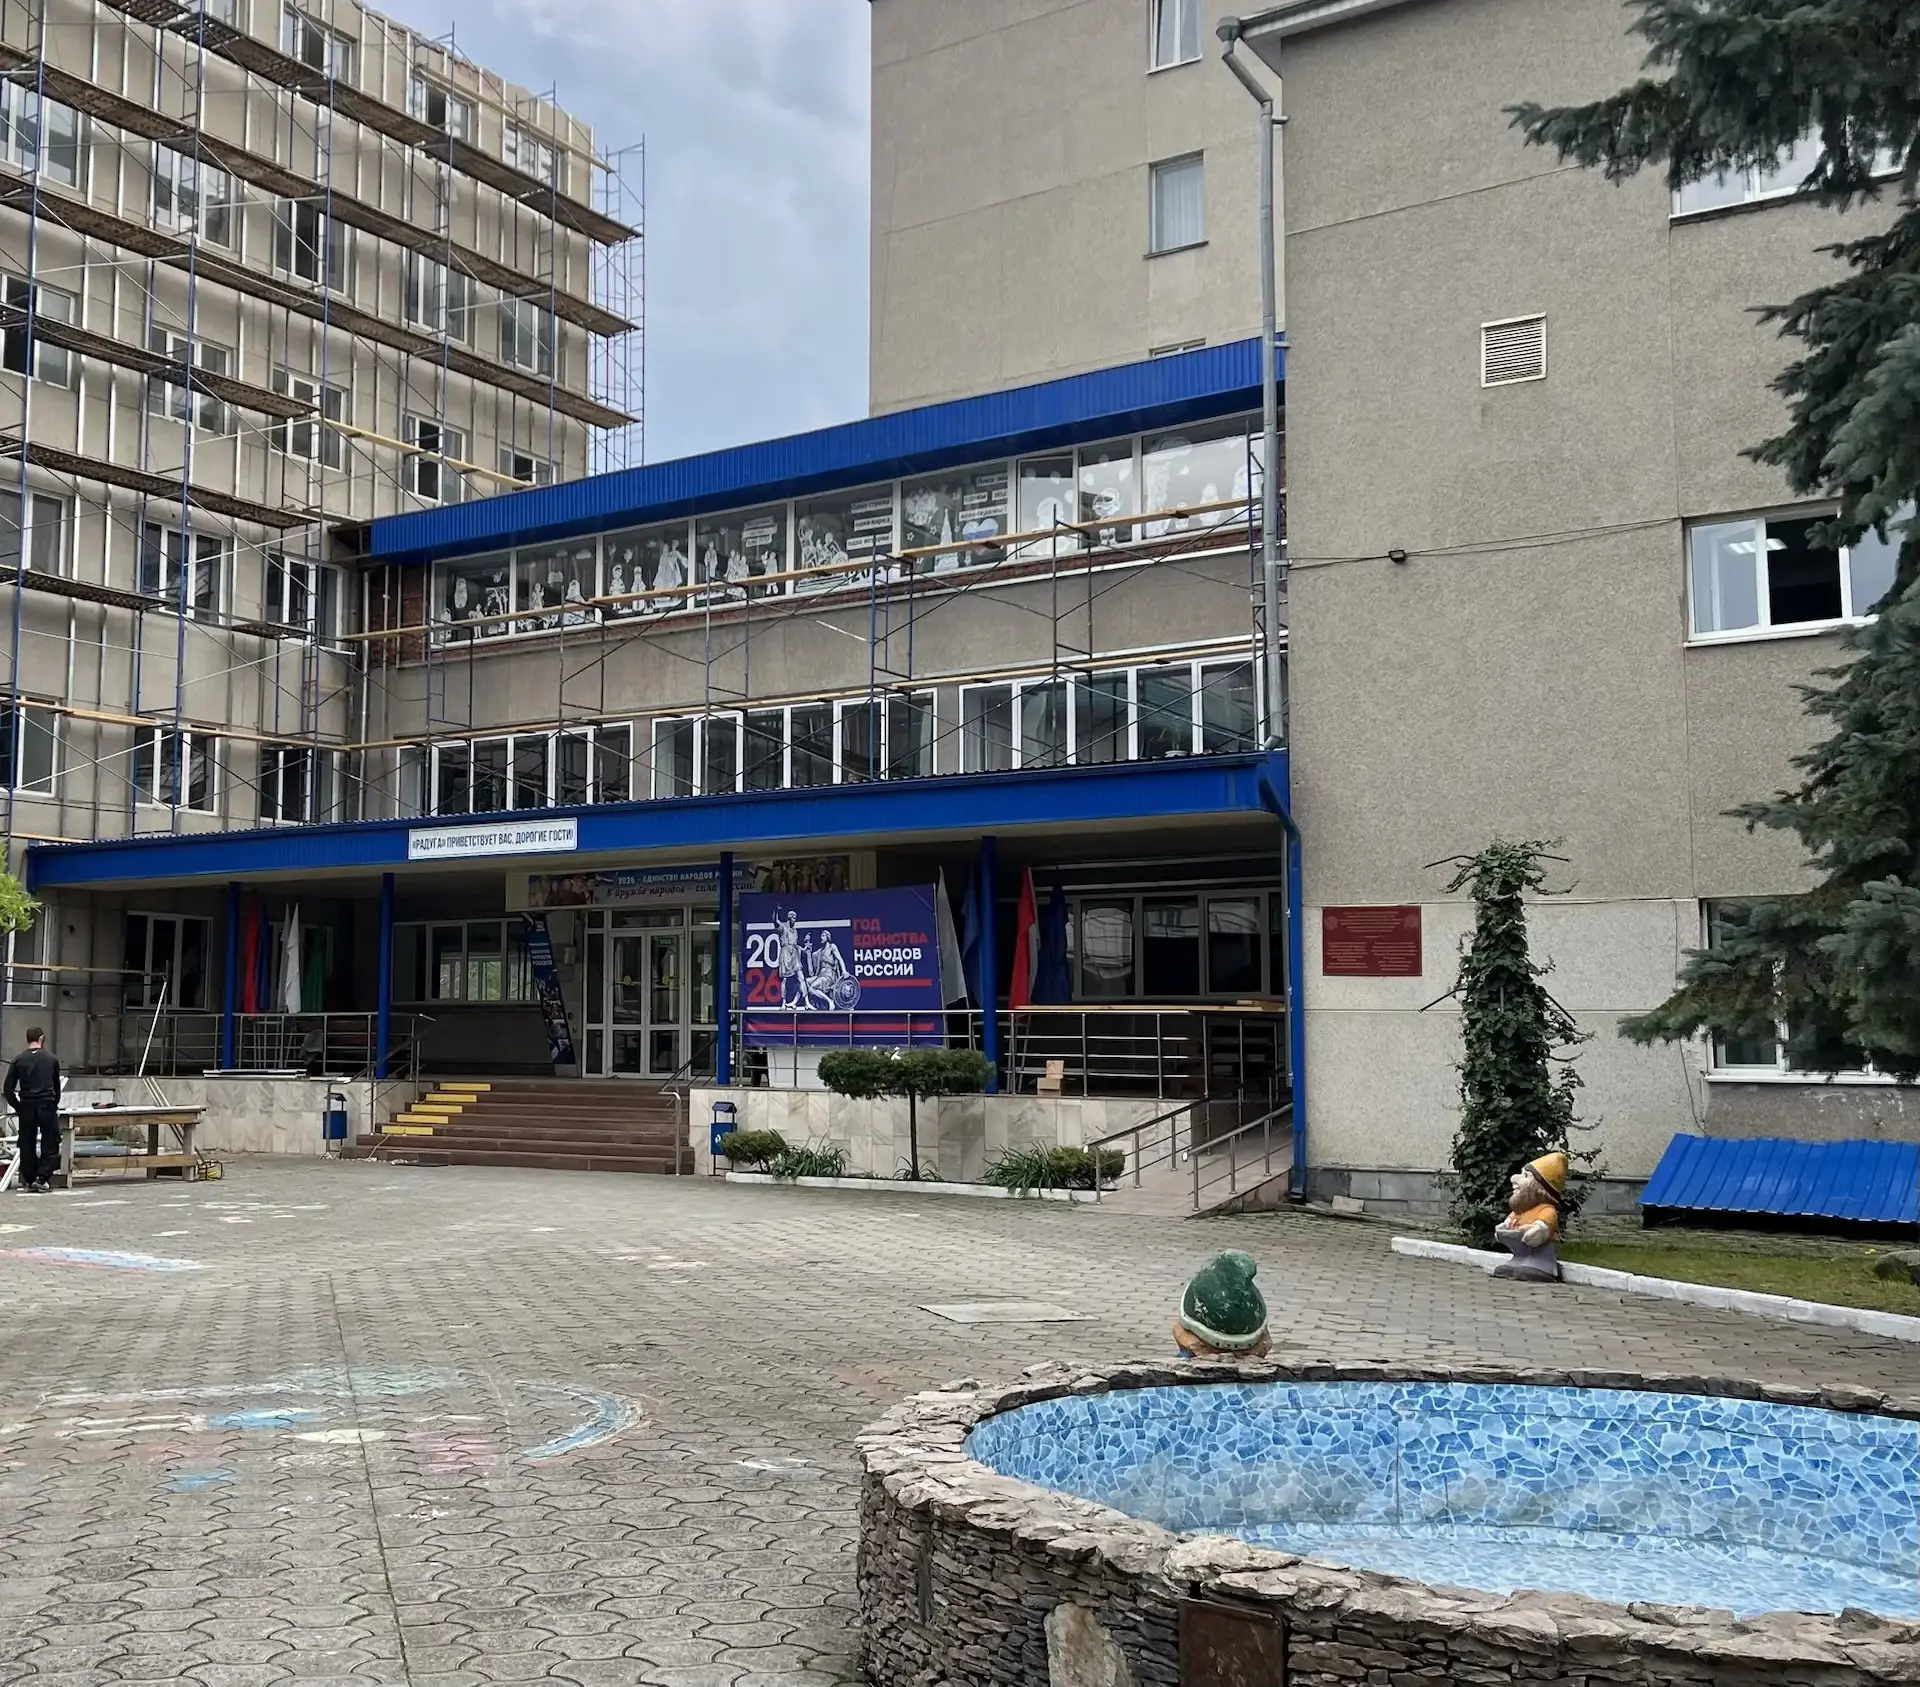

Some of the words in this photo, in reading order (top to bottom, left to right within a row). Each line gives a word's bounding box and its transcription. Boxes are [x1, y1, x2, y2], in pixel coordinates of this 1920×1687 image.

[412, 838, 446, 851] «РАДУГА»
[446, 833, 497, 848] ПРИВЕТСТВУЕТ
[498, 832, 514, 845] ВАС,
[515, 830, 547, 844] ДОРОГИЕ
[548, 828, 574, 842] ГОСТИ!
[680, 871, 713, 881] НАРОДОВ
[650, 884, 685, 897] народов
[853, 919, 881, 932] ГОД
[853, 932, 928, 947] ЕДИНСТВА
[746, 933, 781, 968] 20
[853, 948, 922, 963] НАРОДОВ
[854, 963, 914, 977] РОССИИ
[746, 968, 782, 1003] 26
